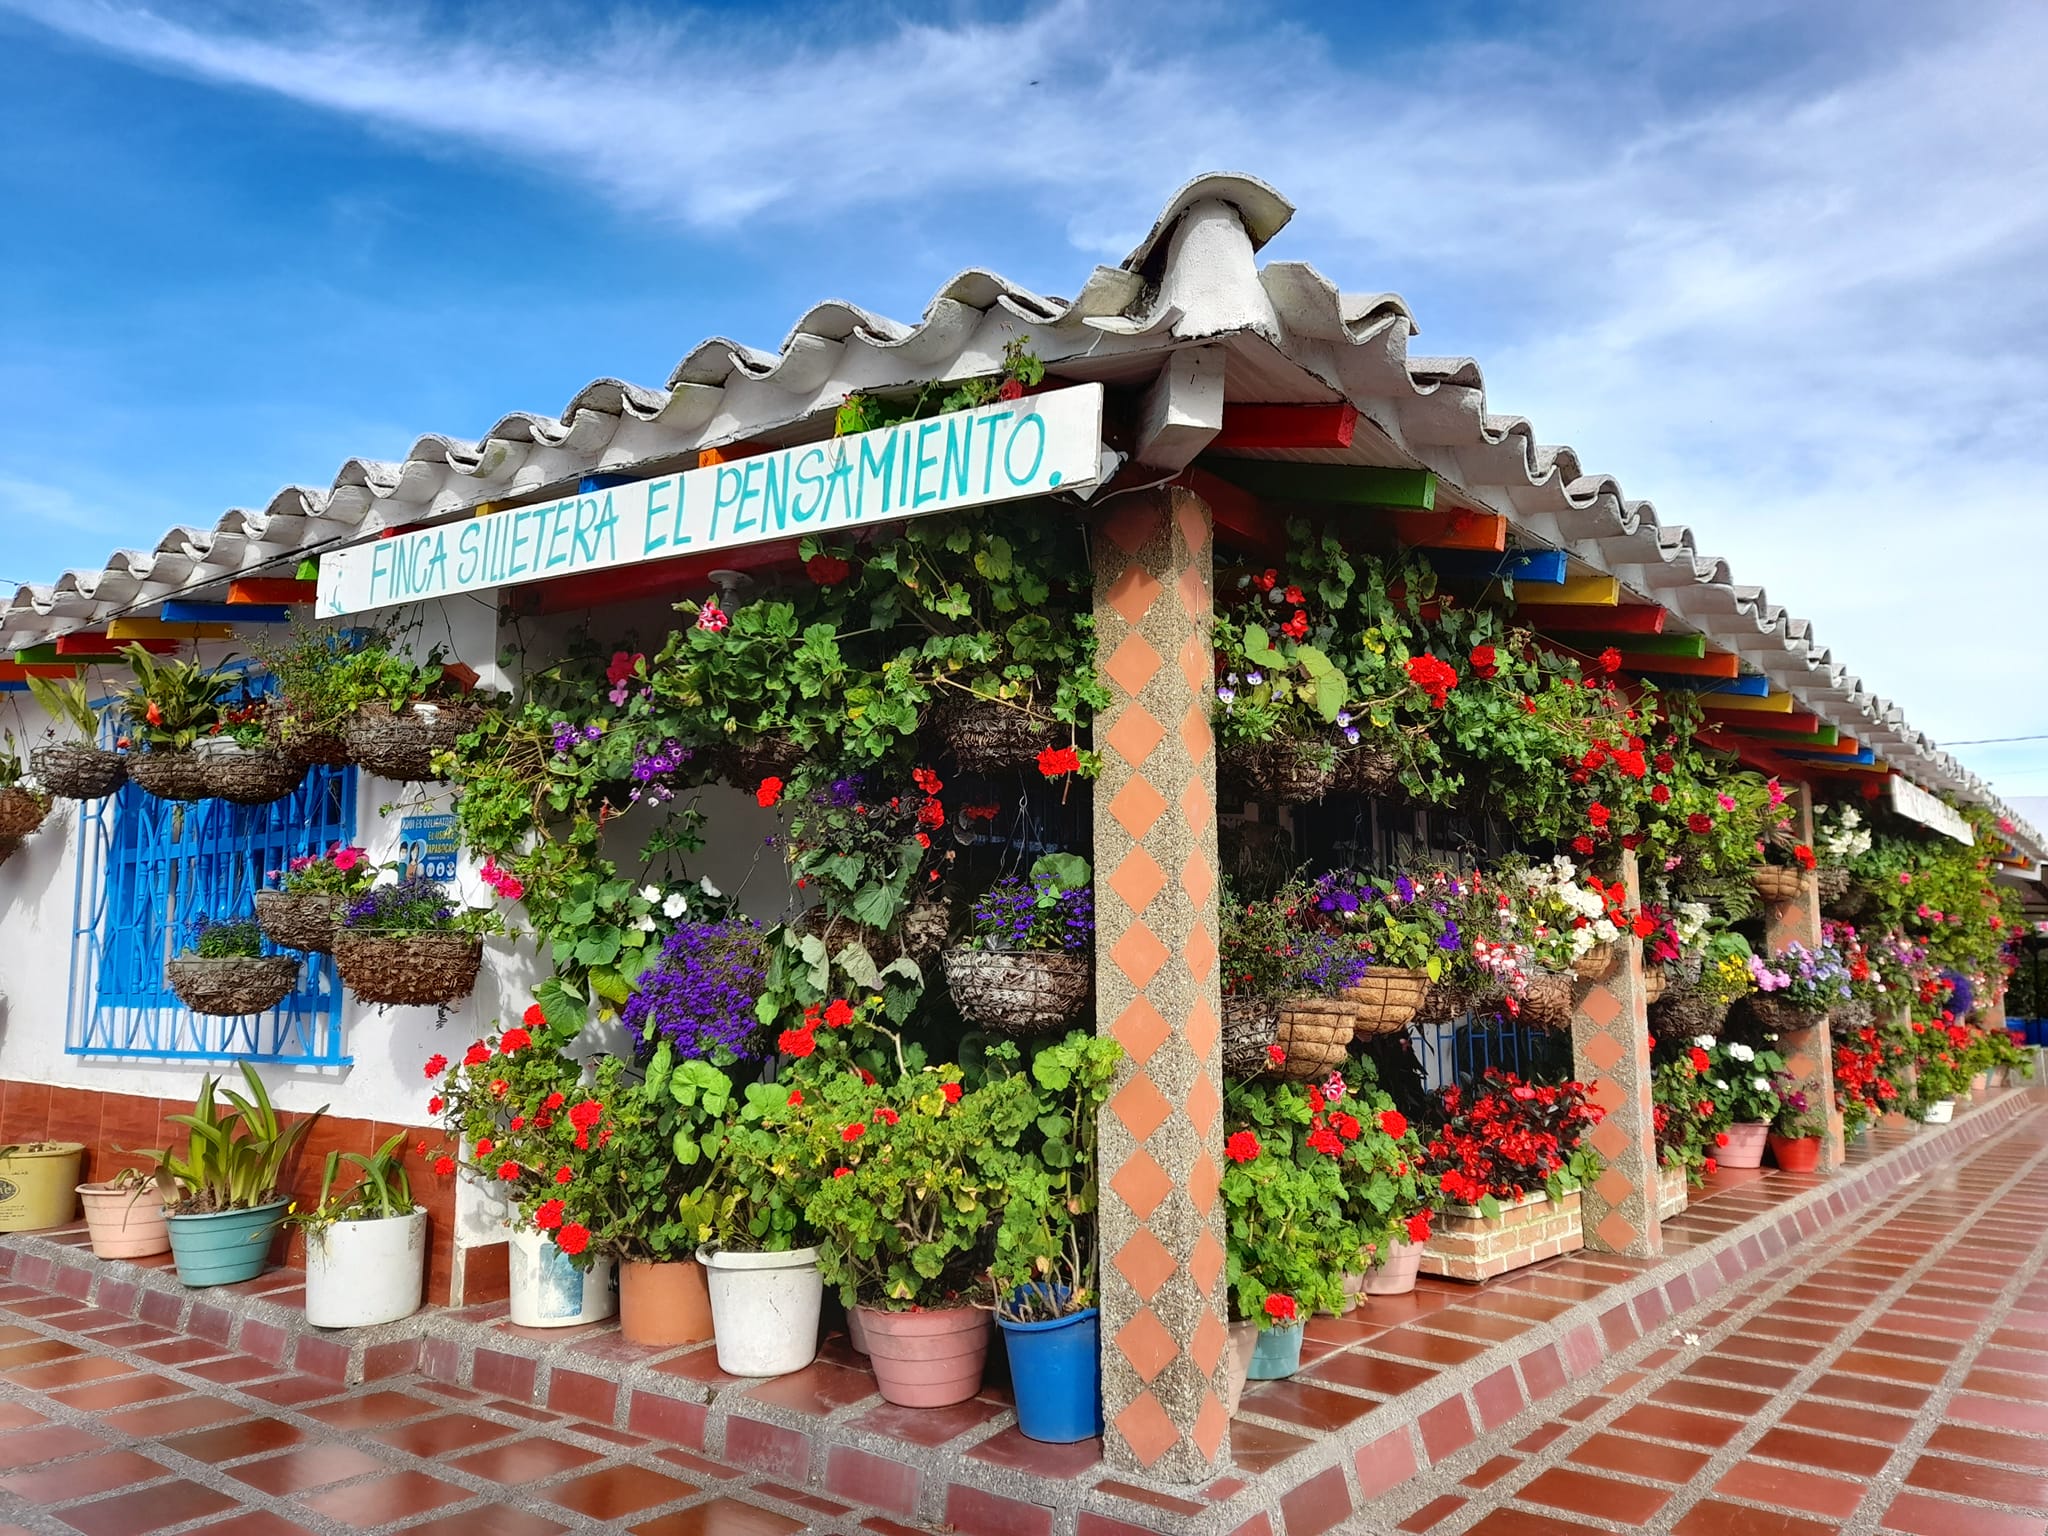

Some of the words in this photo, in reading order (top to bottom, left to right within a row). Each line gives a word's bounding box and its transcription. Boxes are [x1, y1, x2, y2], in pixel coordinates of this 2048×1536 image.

[369, 530, 448, 605] FINCA
[457, 490, 620, 585] SILLETERA
[643, 472, 692, 556] EL
[709, 411, 1062, 541] PENSAMIENTO.
